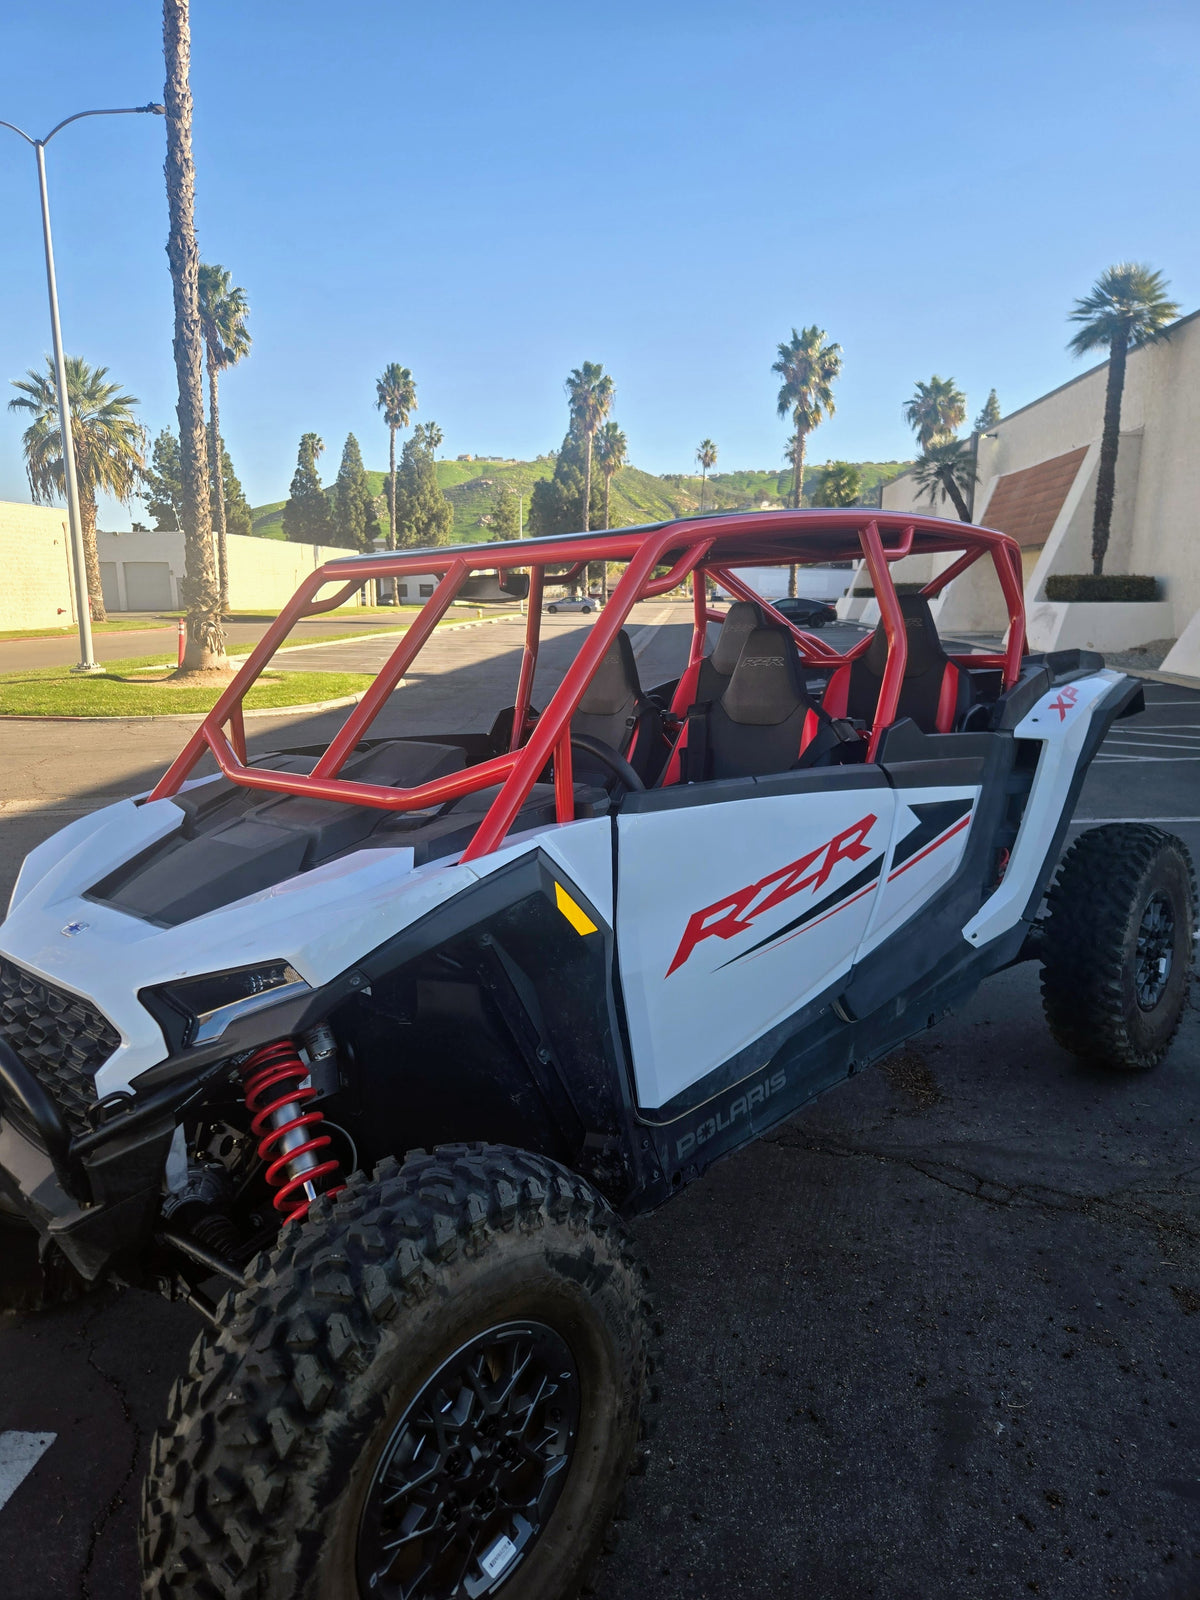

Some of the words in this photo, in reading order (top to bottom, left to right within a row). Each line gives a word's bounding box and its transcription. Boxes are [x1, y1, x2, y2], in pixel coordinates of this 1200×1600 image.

[740, 656, 785, 668] RZR
[1047, 685, 1080, 723] XP
[664, 812, 878, 980] RZR
[675, 1068, 788, 1161] POLARIS
